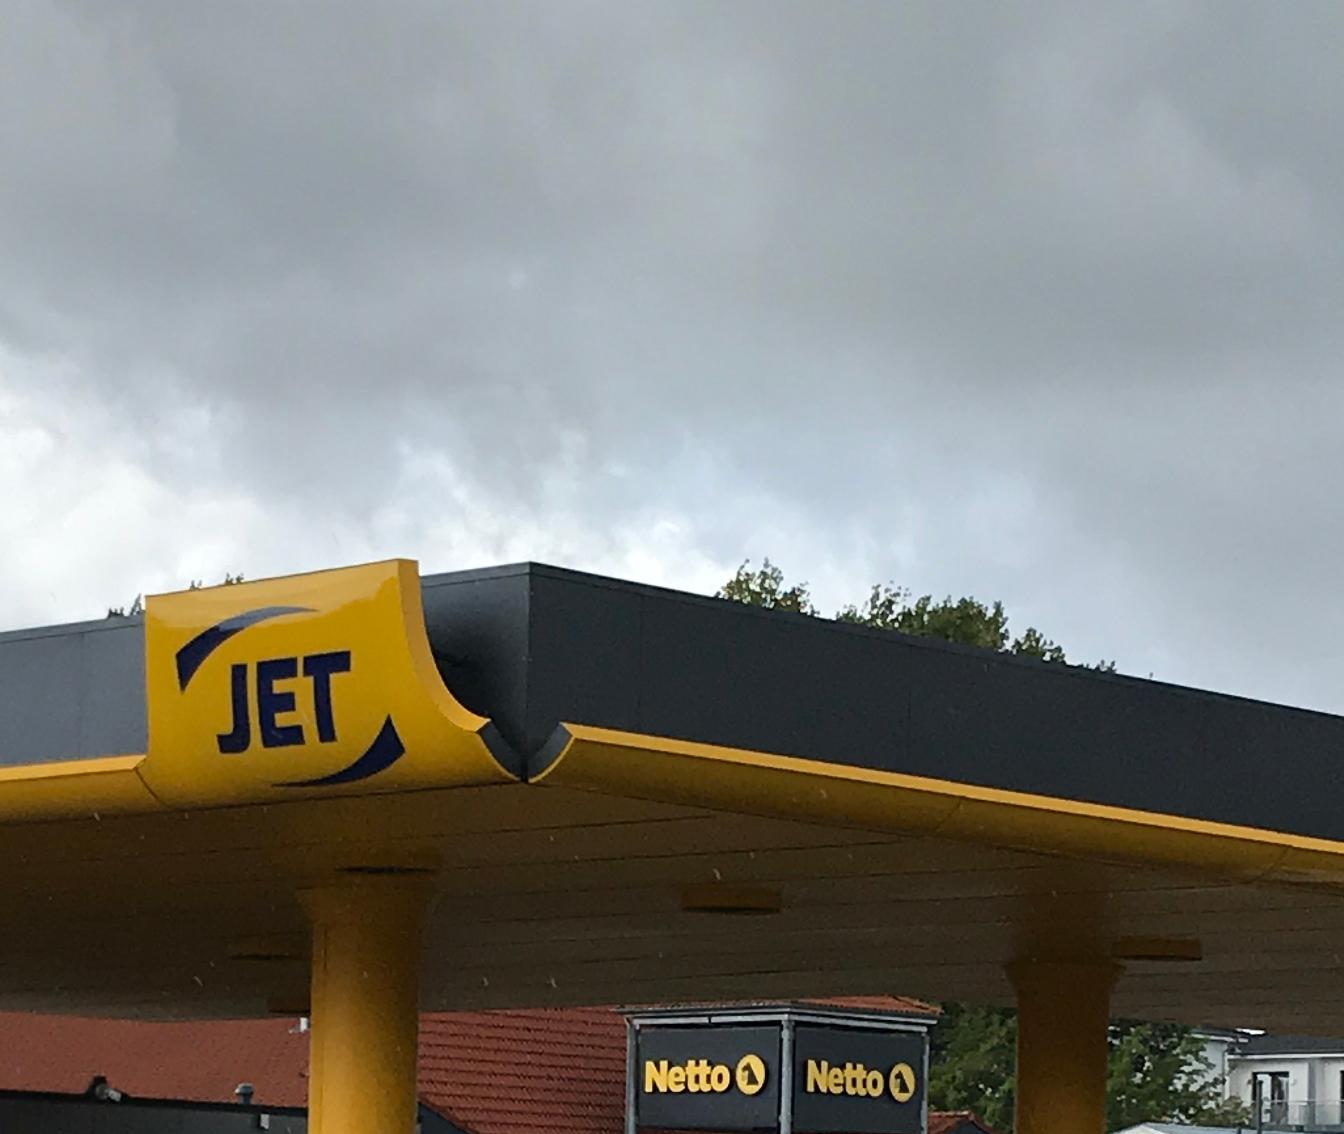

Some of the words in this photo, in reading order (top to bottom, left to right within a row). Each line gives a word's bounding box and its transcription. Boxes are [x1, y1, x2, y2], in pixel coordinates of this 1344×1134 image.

[216, 650, 352, 754] JET
[644, 1059, 731, 1093] Netto
[806, 1059, 885, 1098] Netto
